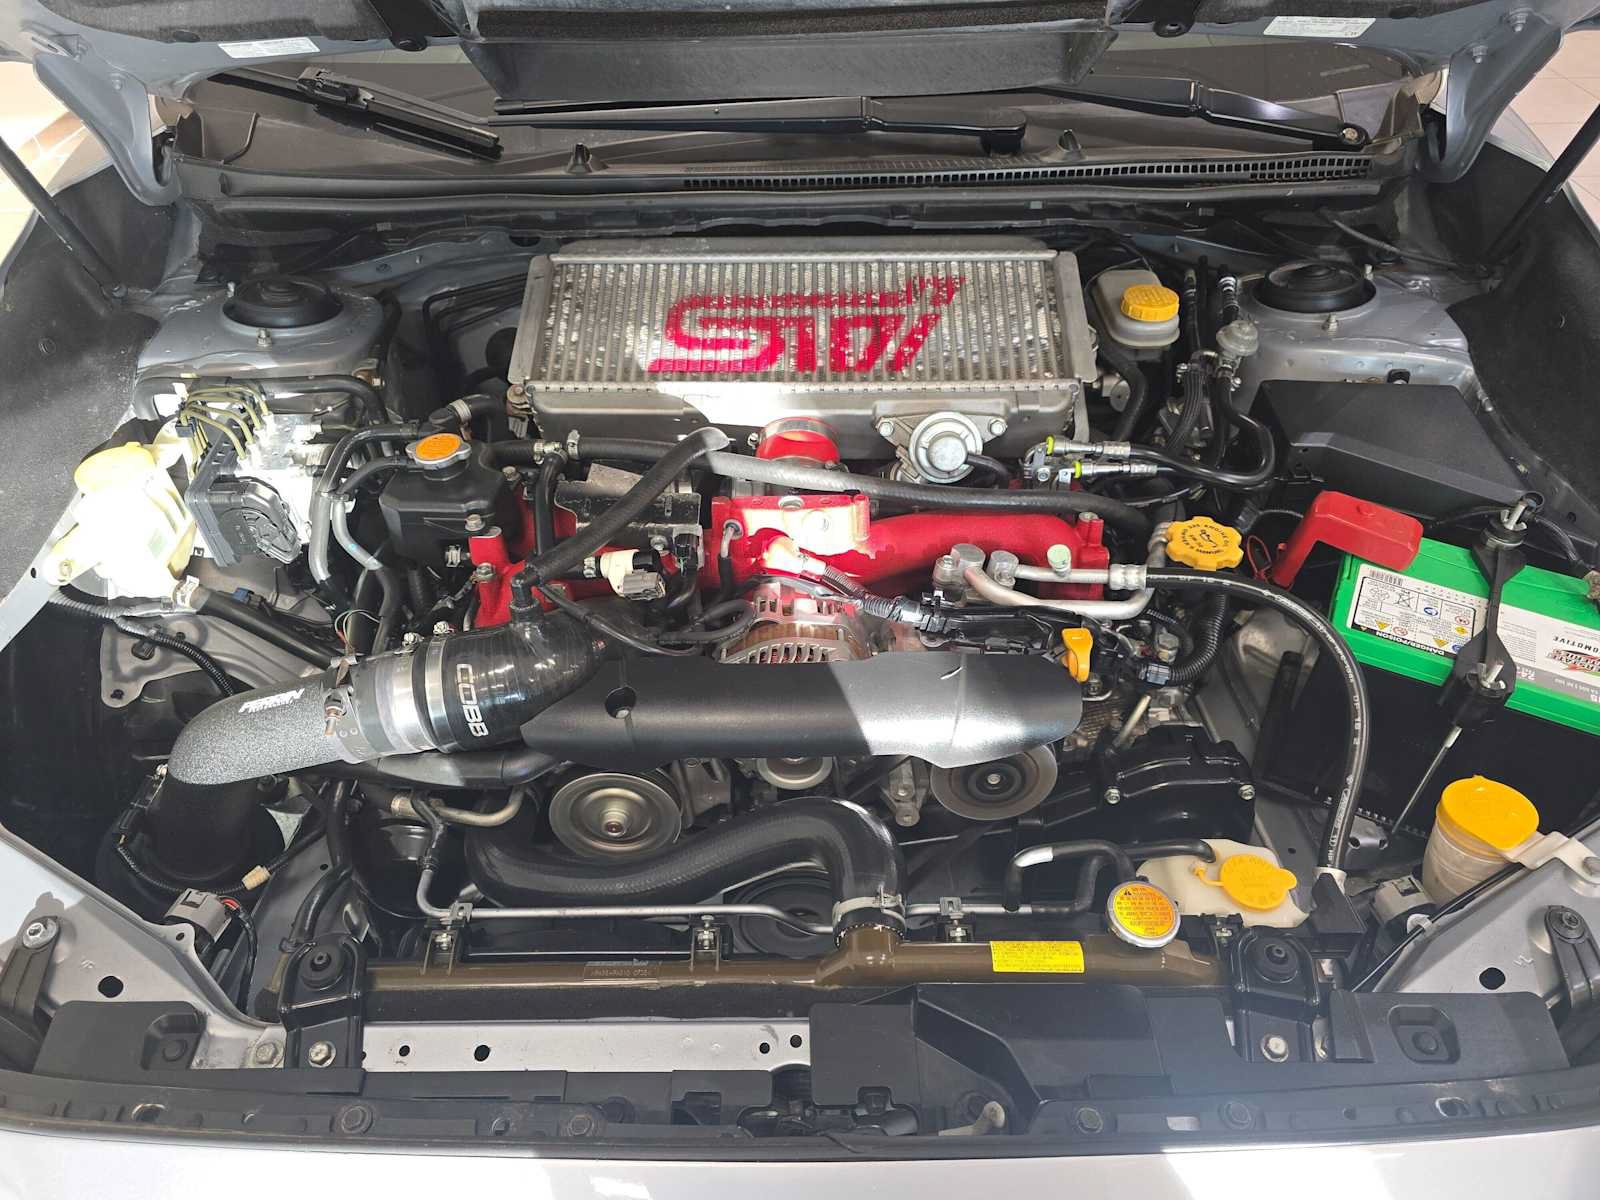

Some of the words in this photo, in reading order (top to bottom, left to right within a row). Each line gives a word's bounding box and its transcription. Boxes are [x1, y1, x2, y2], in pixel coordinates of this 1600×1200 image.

[1375, 631, 1445, 656] DANGER/POISON
[1552, 635, 1600, 655] OMOTIVE
[456, 663, 488, 737] COBB
